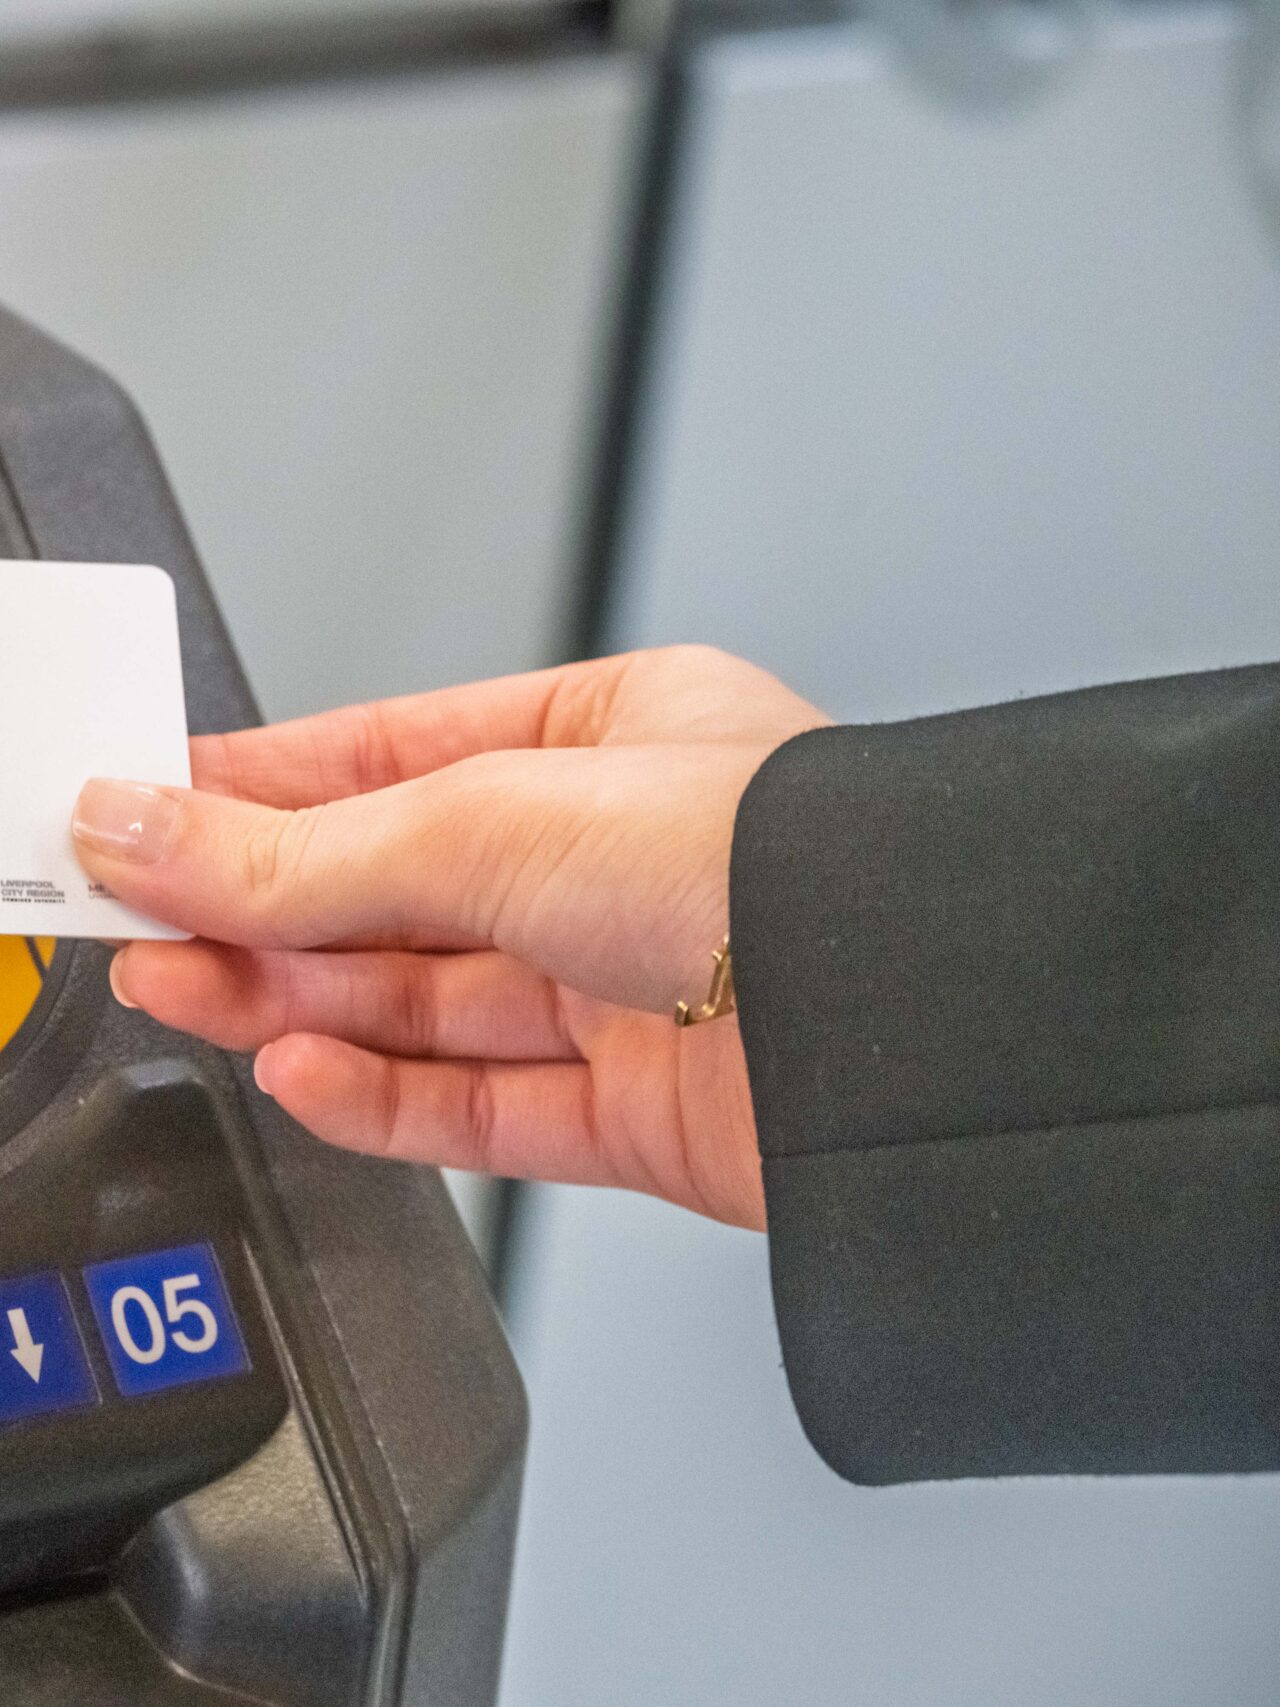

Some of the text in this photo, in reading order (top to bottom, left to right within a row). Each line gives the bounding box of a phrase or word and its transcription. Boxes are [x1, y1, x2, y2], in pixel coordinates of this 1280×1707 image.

[0, 879, 56, 889] LIVERPOOL
[1, 889, 65, 898] CITY REGION
[110, 1273, 218, 1365] 05
